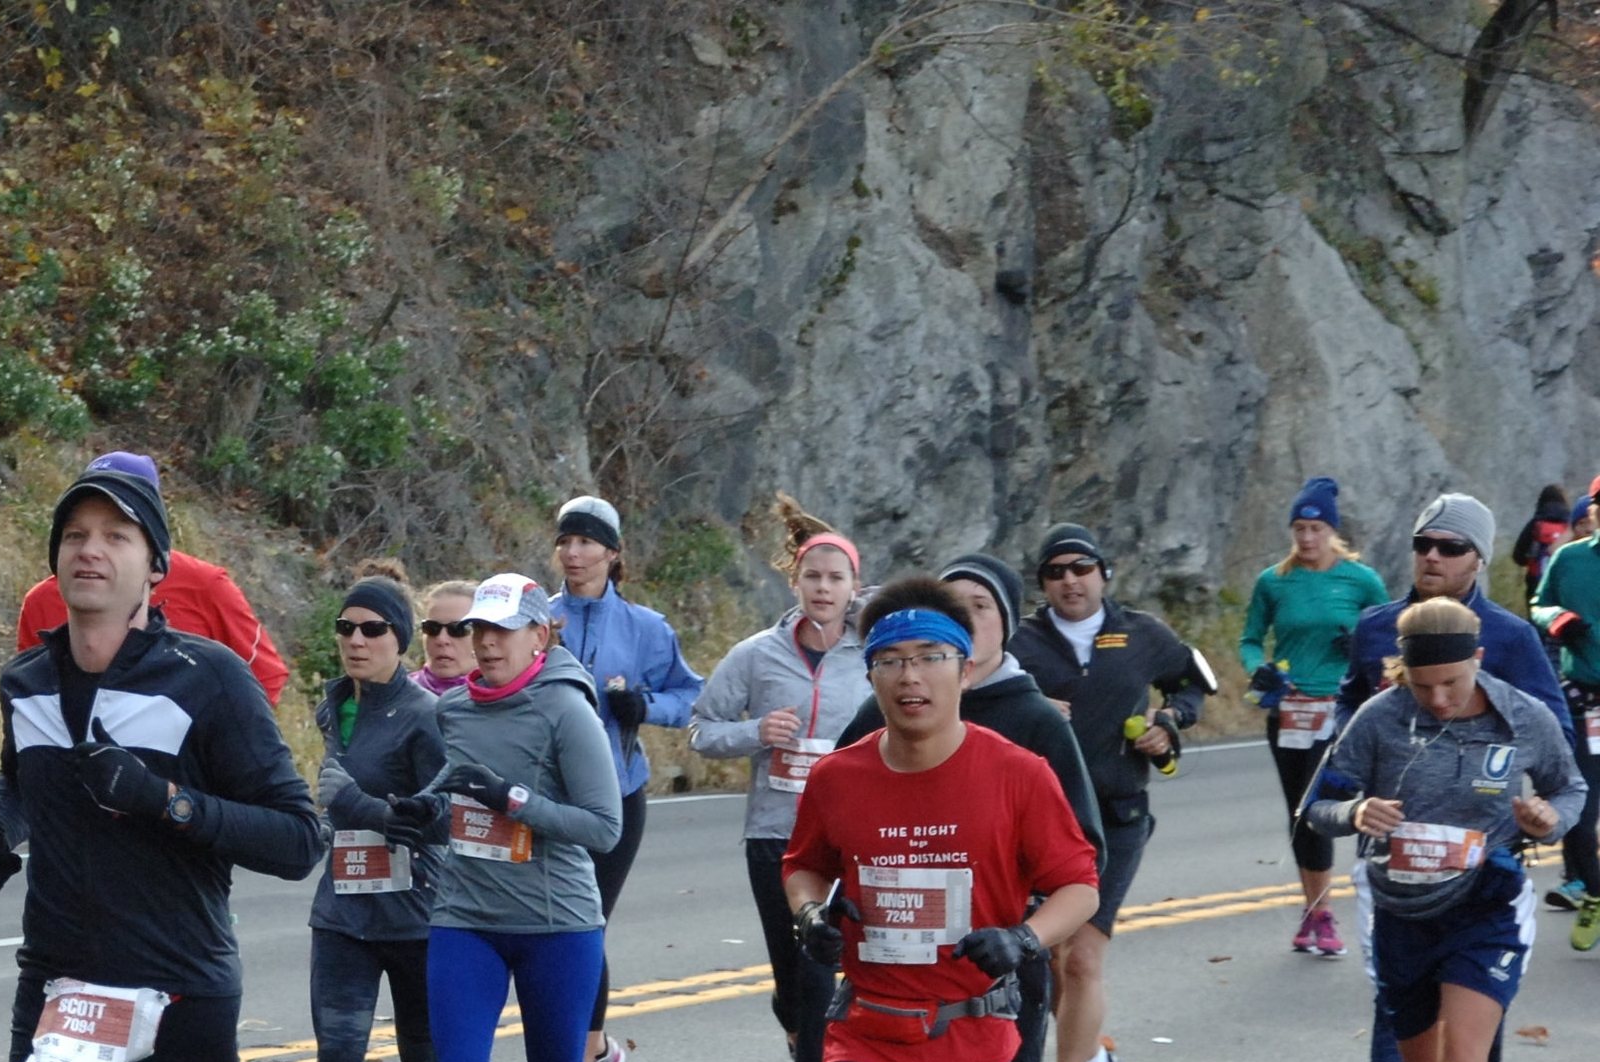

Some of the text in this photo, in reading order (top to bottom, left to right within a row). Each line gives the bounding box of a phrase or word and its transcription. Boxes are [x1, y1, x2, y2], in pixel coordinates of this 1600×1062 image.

[878, 824, 958, 838] THE RIGHT
[344, 850, 368, 864] JULIE
[871, 852, 968, 867] YOUR DISTANCE
[876, 892, 924, 909] XINGYU
[885, 909, 916, 923] 7244
[57, 998, 107, 1020] SCOTT
[61, 1015, 97, 1035] 7094
